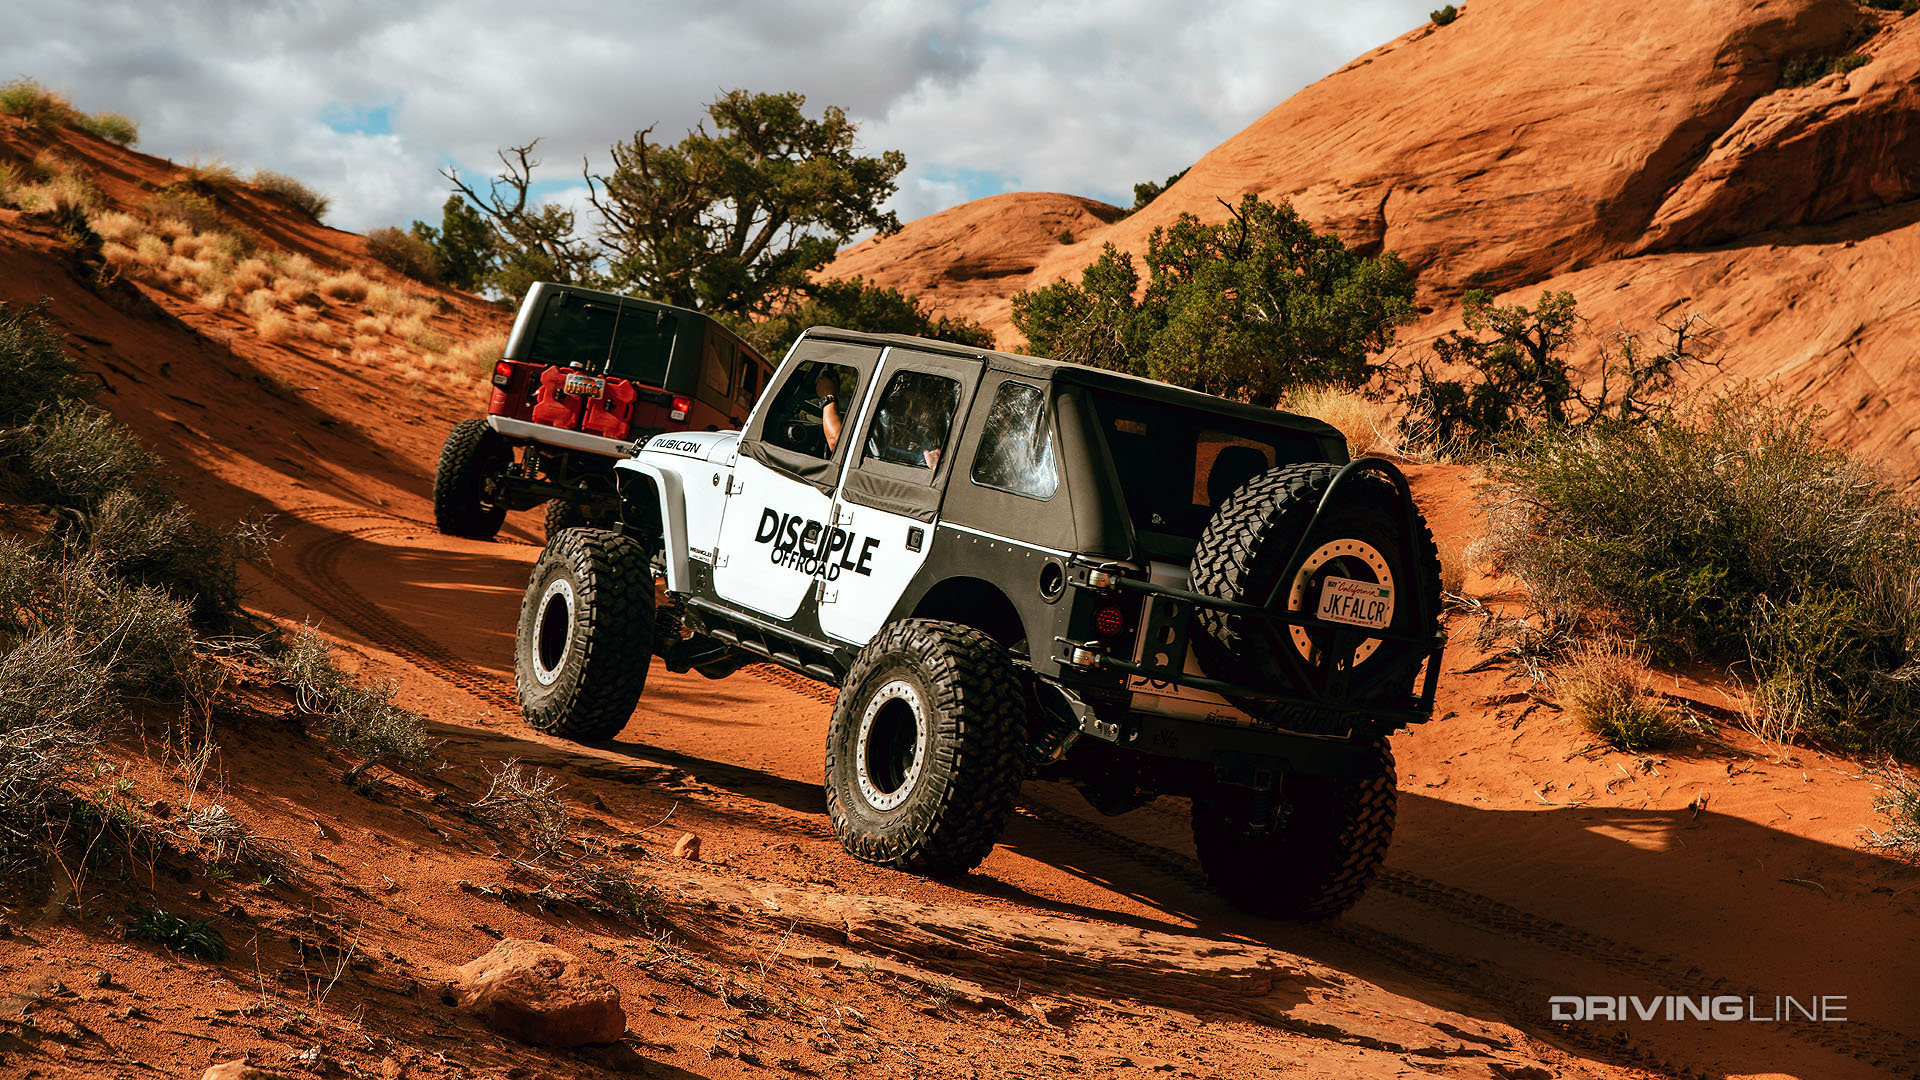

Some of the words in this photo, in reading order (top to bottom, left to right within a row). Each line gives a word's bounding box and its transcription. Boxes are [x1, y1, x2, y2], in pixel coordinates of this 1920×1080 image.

[653, 439, 702, 453] RUBICON
[755, 507, 880, 577] DISCIPLE
[771, 546, 841, 581] OFFROAD
[1338, 582, 1380, 597] California
[1323, 593, 1386, 622] JKFALCR
